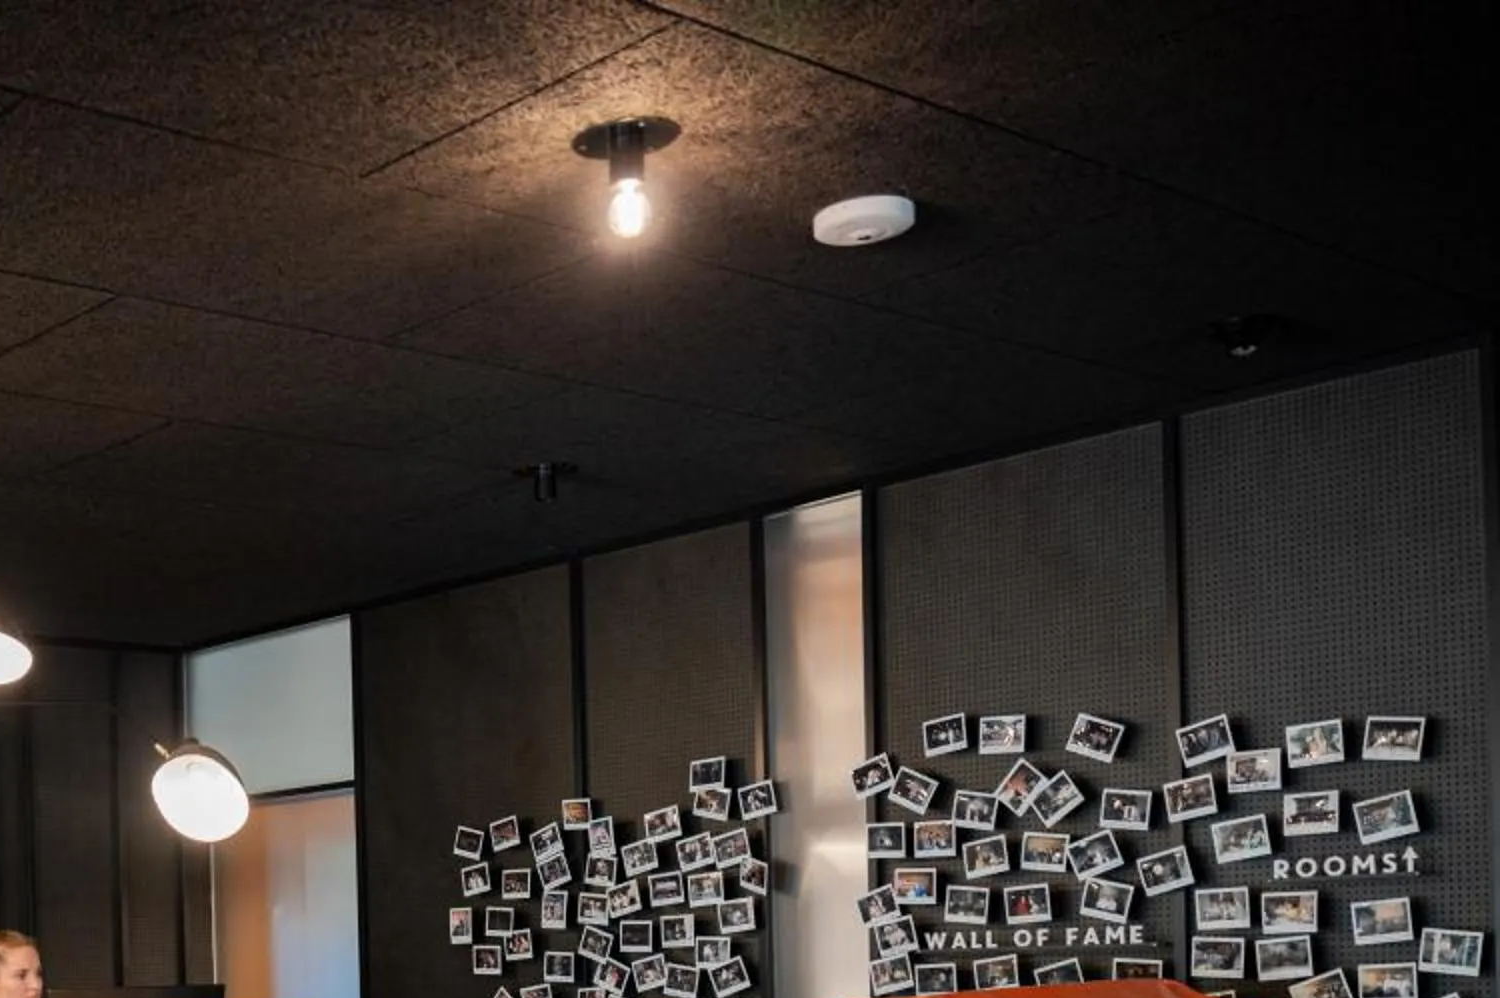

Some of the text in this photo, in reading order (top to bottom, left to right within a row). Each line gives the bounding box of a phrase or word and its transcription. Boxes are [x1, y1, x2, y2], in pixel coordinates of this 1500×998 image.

[1272, 853, 1398, 880] ROOMS
[925, 925, 1144, 950] WALL OF FAME
